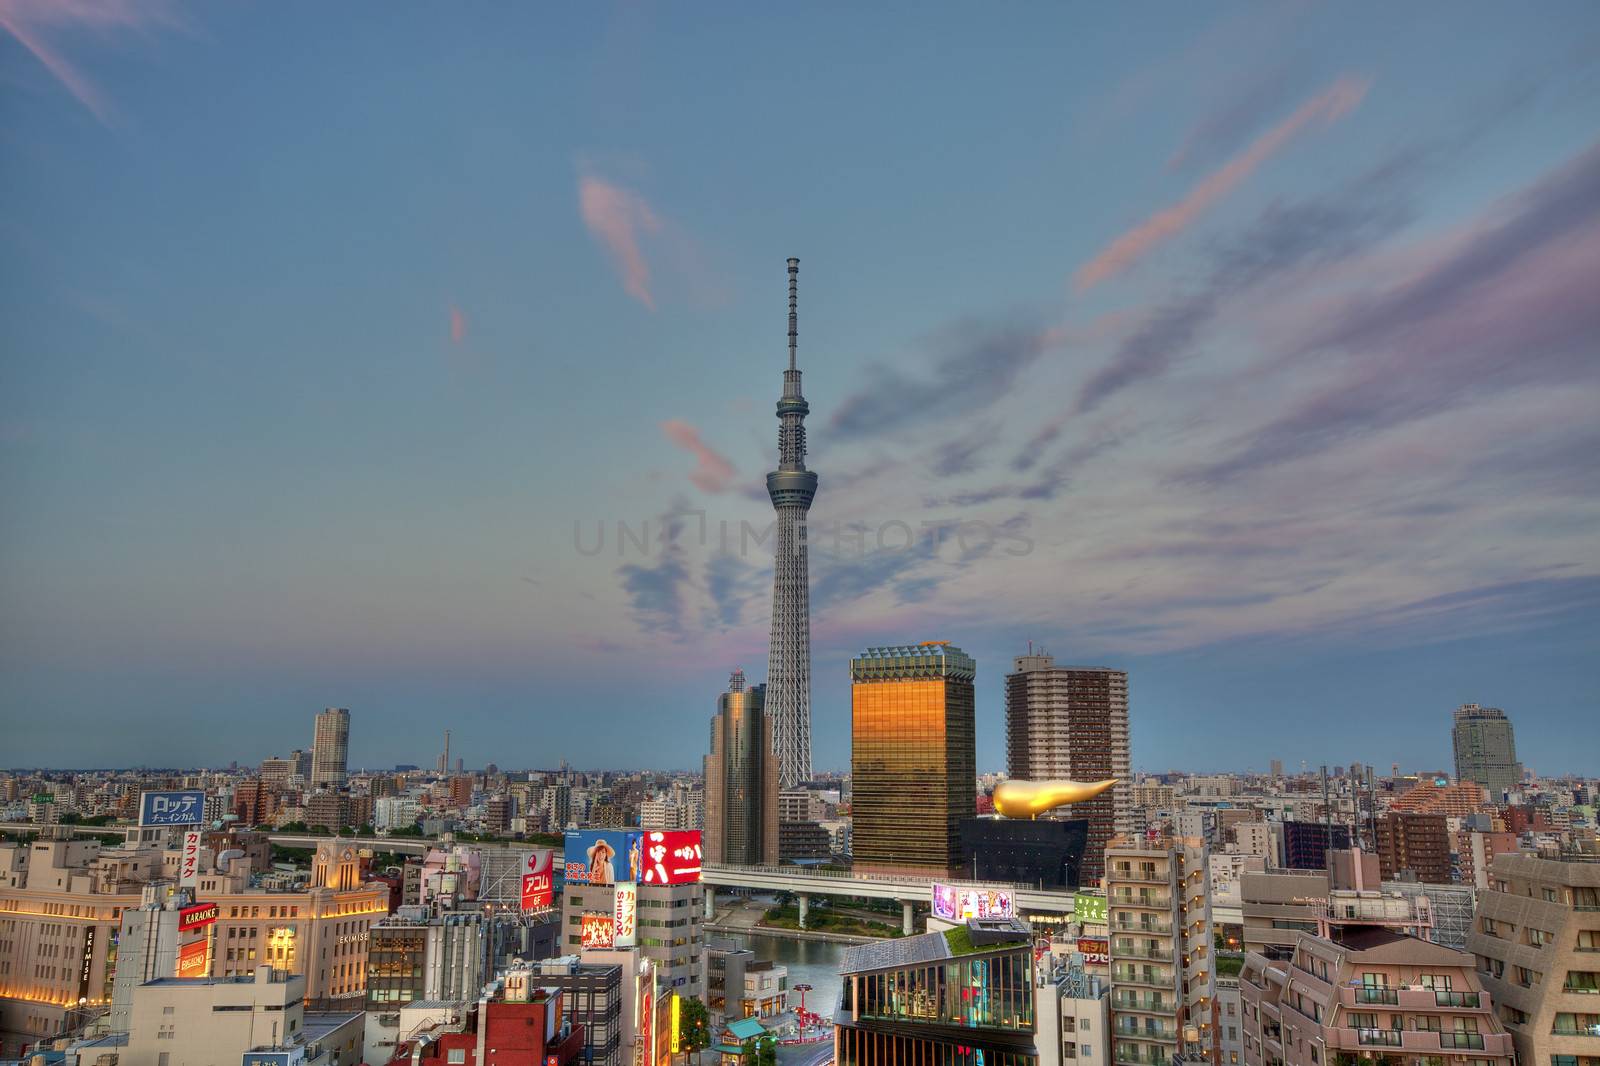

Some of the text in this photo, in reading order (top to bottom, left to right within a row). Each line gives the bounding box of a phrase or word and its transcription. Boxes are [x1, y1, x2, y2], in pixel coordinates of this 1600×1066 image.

[152, 796, 197, 813] ロッテ
[151, 812, 196, 823] チューインガム
[183, 833, 198, 878] カラオケ
[526, 874, 549, 893] アコム
[533, 895, 541, 905] 6F
[185, 908, 216, 925] KARAOKE
[616, 891, 625, 937] SHIDAX
[624, 890, 635, 937] カラオケ
[339, 933, 368, 944] EKIMISE
[84, 932, 93, 981] EKIMISE
